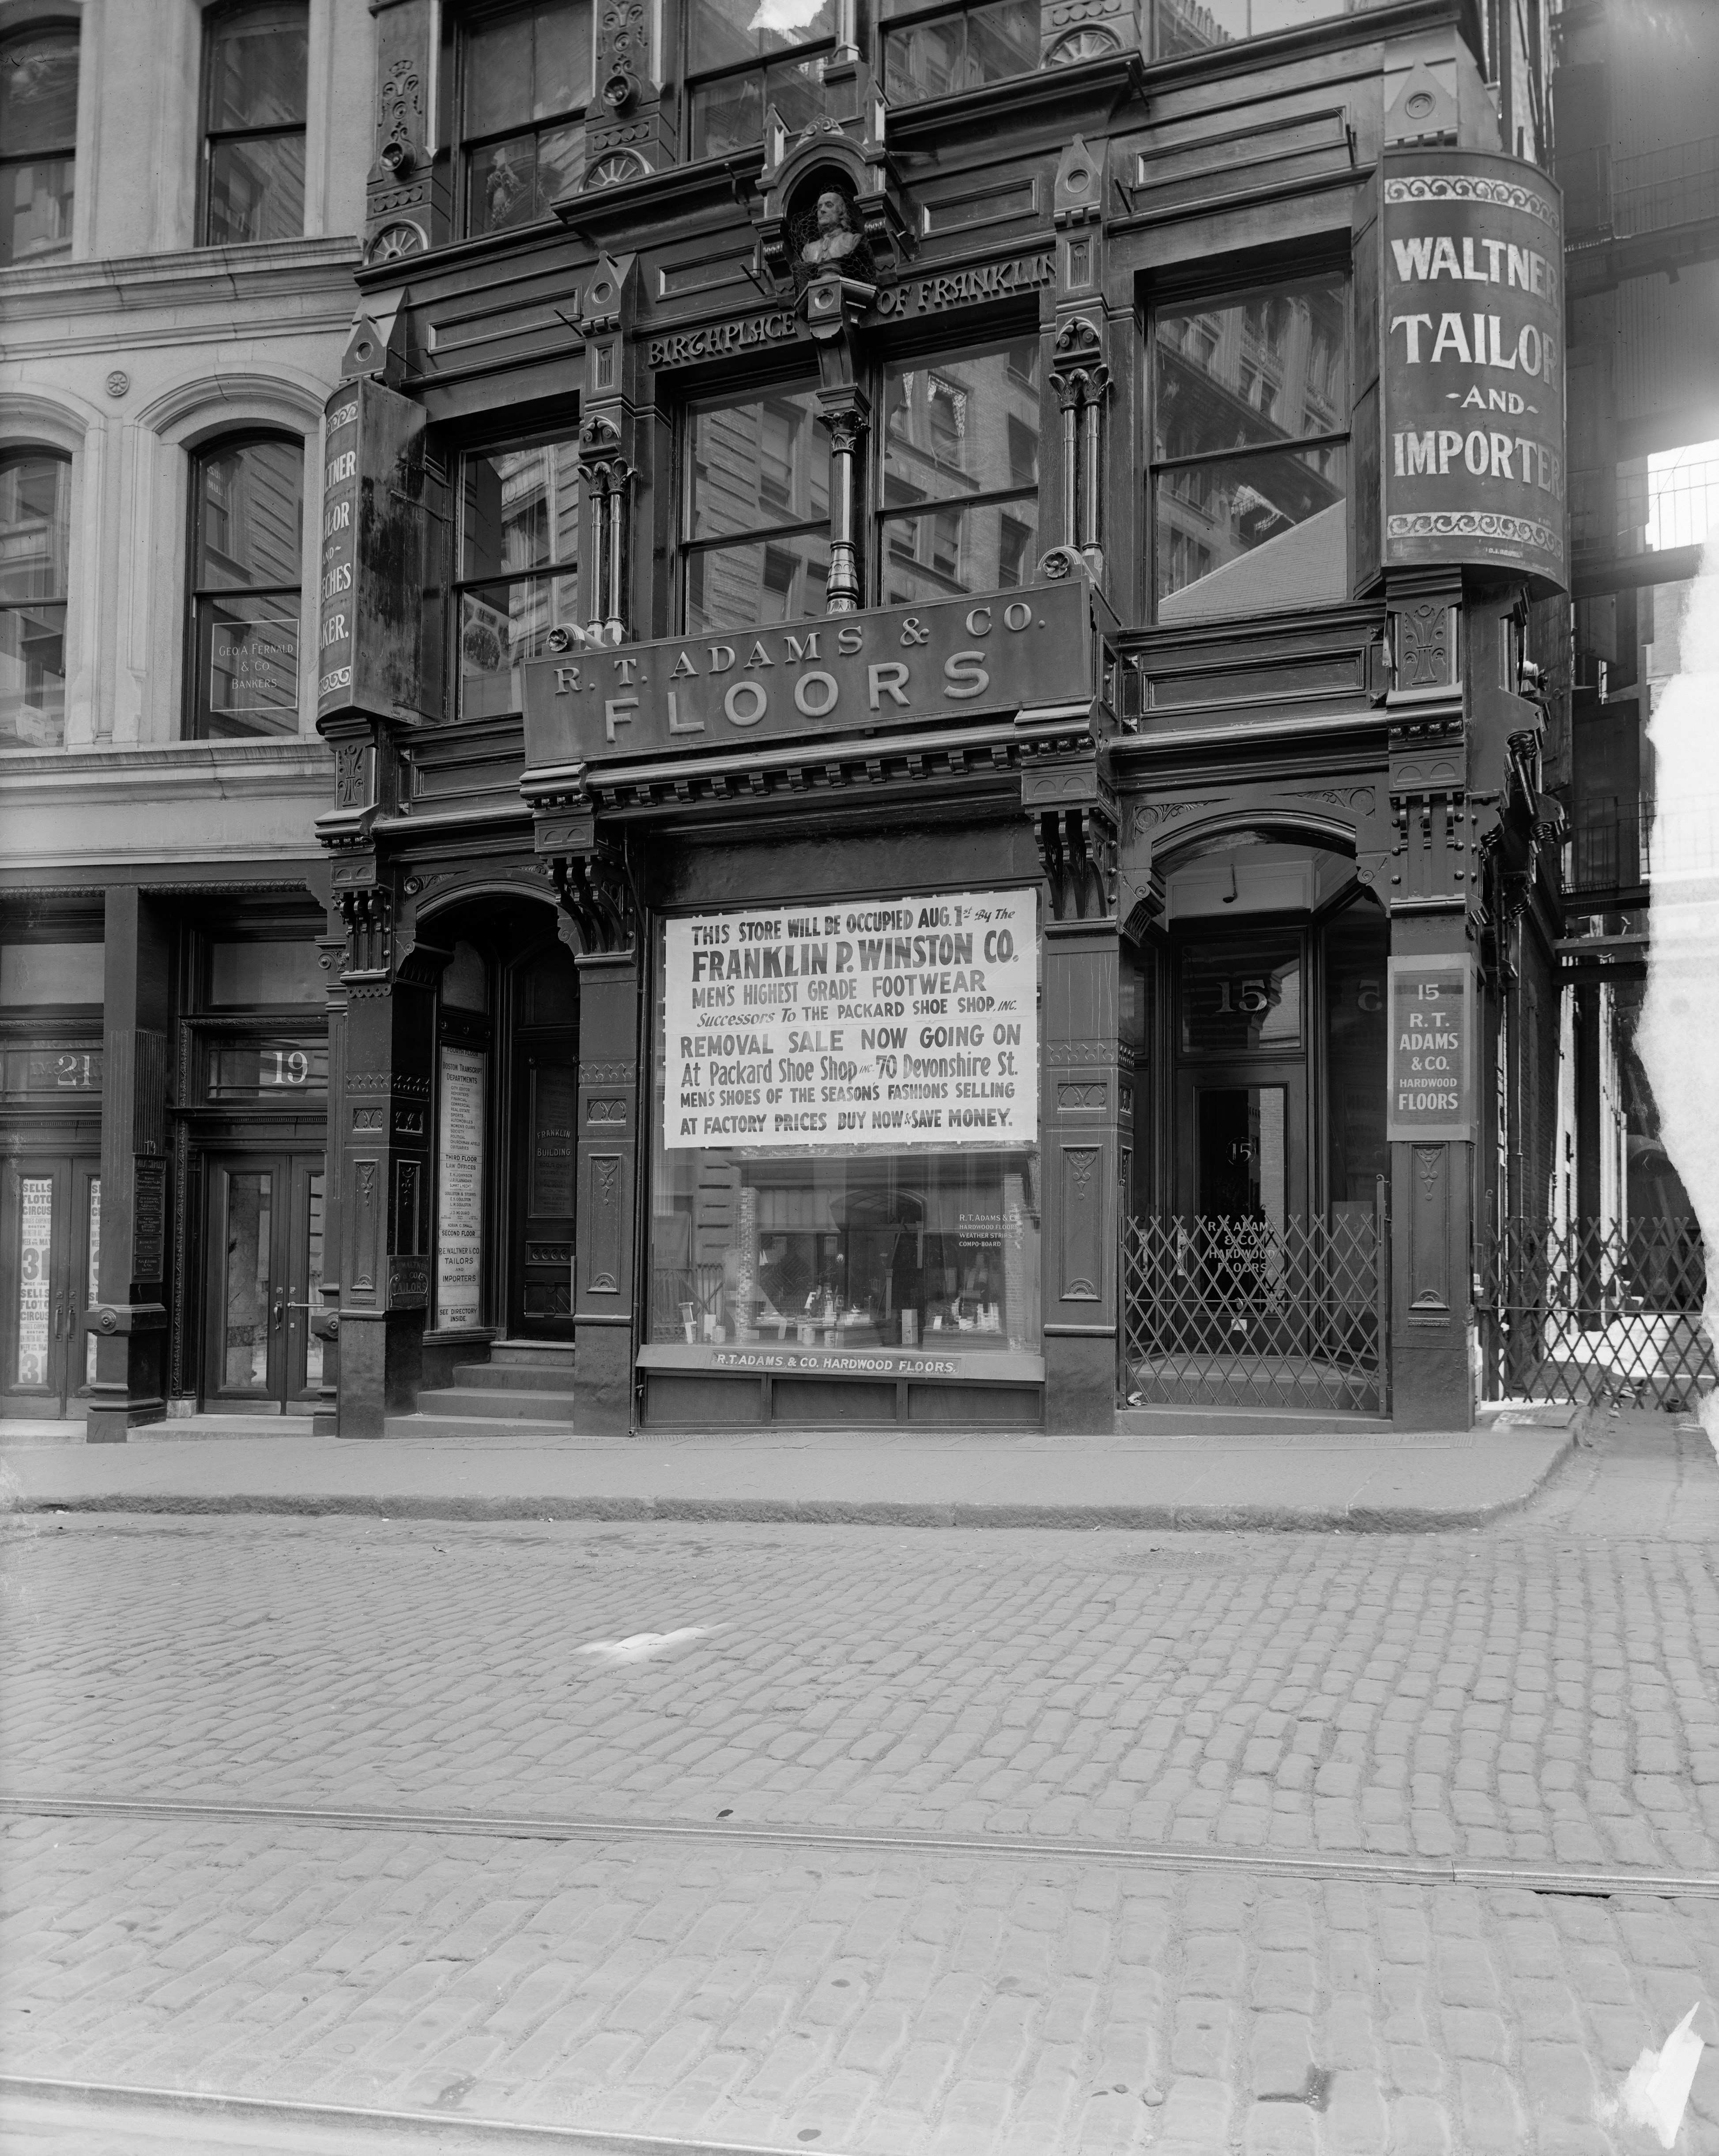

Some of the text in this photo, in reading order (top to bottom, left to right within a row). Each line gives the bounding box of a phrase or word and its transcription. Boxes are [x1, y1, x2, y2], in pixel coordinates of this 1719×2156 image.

[1391, 236, 1557, 304] WALTNER
[647, 255, 1056, 367] BIRTHPLACE OF FRANKLIN
[1390, 312, 1557, 392] TAILOR
[1392, 430, 1561, 501] IMPORTER
[219, 643, 293, 656] GEO. A. FERNALD
[669, 625, 863, 679] ADAMS
[899, 617, 930, 647] &
[965, 602, 1046, 637] CO.
[241, 661, 249, 672] &
[232, 678, 277, 689] BANKERS
[604, 651, 991, 743] FLOORS
[691, 905, 1016, 946] THIS STORE WILL BE OCCUPIED AUG. 1st By The
[691, 929, 1019, 982] FRANKLIN P. WINSTON CO.
[692, 969, 987, 1009] MEN'S HIGHEST GRADE FOOTWEAR
[1215, 980, 1267, 1012] 15
[1418, 983, 1440, 1001] 15
[697, 996, 1018, 1027] Successors To THE PACKARD SHOE SHOP, INC.
[680, 1023, 1021, 1058] REMOVAL SALE NOW GOING ON
[1399, 1032, 1459, 1050] ADAMS
[447, 1047, 464, 1056] FOURTH
[57, 1055, 94, 1086] 21
[271, 1051, 309, 1085] 19
[442, 1061, 483, 1074] BOSTON TRANSCRIPT
[680, 1062, 701, 1087] At
[709, 1058, 773, 1086] Packard
[779, 1057, 814, 1083] Shoe
[821, 1055, 857, 1084] Shop
[876, 1054, 897, 1080] 70
[903, 1051, 991, 1079] Devonshire
[998, 1051, 1018, 1076] St.
[1411, 1056, 1450, 1071] & CO.
[446, 1072, 478, 1084] DEPARTMENTS
[1399, 1078, 1457, 1087] HARDWOOD
[680, 1082, 1015, 1108] MEN'S SHOES OF THE SEASON'S FASHIONS SELLING
[1399, 1093, 1458, 1110] FLOORS
[680, 1117, 698, 1136] AT
[704, 1114, 767, 1135] FACTORY
[774, 1112, 827, 1132] PRICES
[838, 1111, 867, 1130] BUY
[872, 1110, 904, 1129] NOW
[911, 1109, 942, 1129] SAVE
[948, 1108, 1013, 1128] MONEY.
[537, 1129, 571, 1140] FRANKLIN
[537, 1148, 572, 1157] BUILDING.
[1232, 1143, 1252, 1162] 15
[23, 1183, 52, 1193] SELLS
[23, 1205, 52, 1215] CIRCUS
[1224, 1235, 1236, 1245] &
[1209, 1249, 1275, 1259] HARDWOOD
[23, 1247, 50, 1281] 31
[787, 1357, 797, 1367] &
[799, 1357, 819, 1368] CO.
[823, 1358, 893, 1370] HARDWOOD
[898, 1361, 956, 1373] FLOORS.
